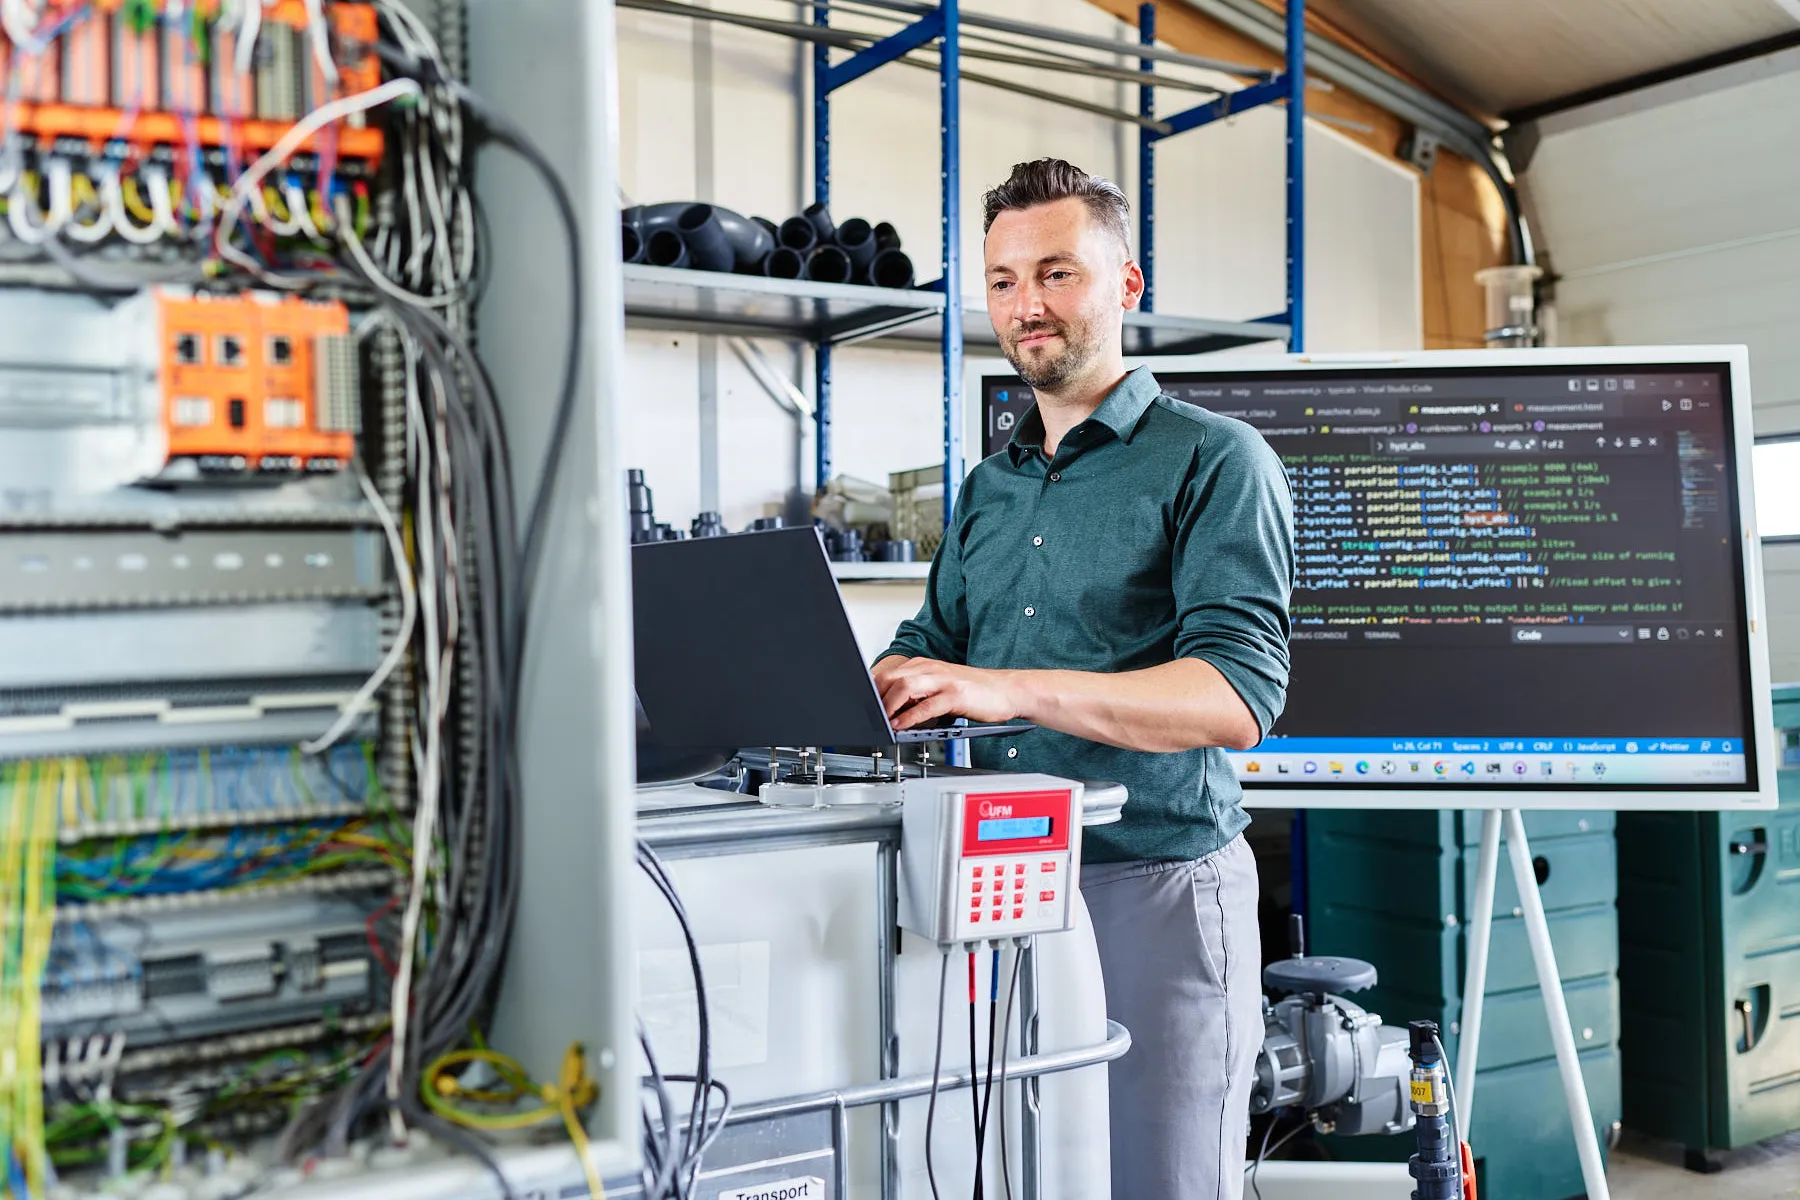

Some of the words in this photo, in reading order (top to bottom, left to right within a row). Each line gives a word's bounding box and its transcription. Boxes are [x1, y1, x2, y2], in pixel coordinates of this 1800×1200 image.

[1187, 388, 1222, 397] Terminal
[1231, 387, 1251, 397] Help
[1362, 385, 1385, 393] Visual
[1387, 384, 1410, 393] Studio
[1412, 383, 1433, 393] Code
[1517, 629, 1542, 641] Code
